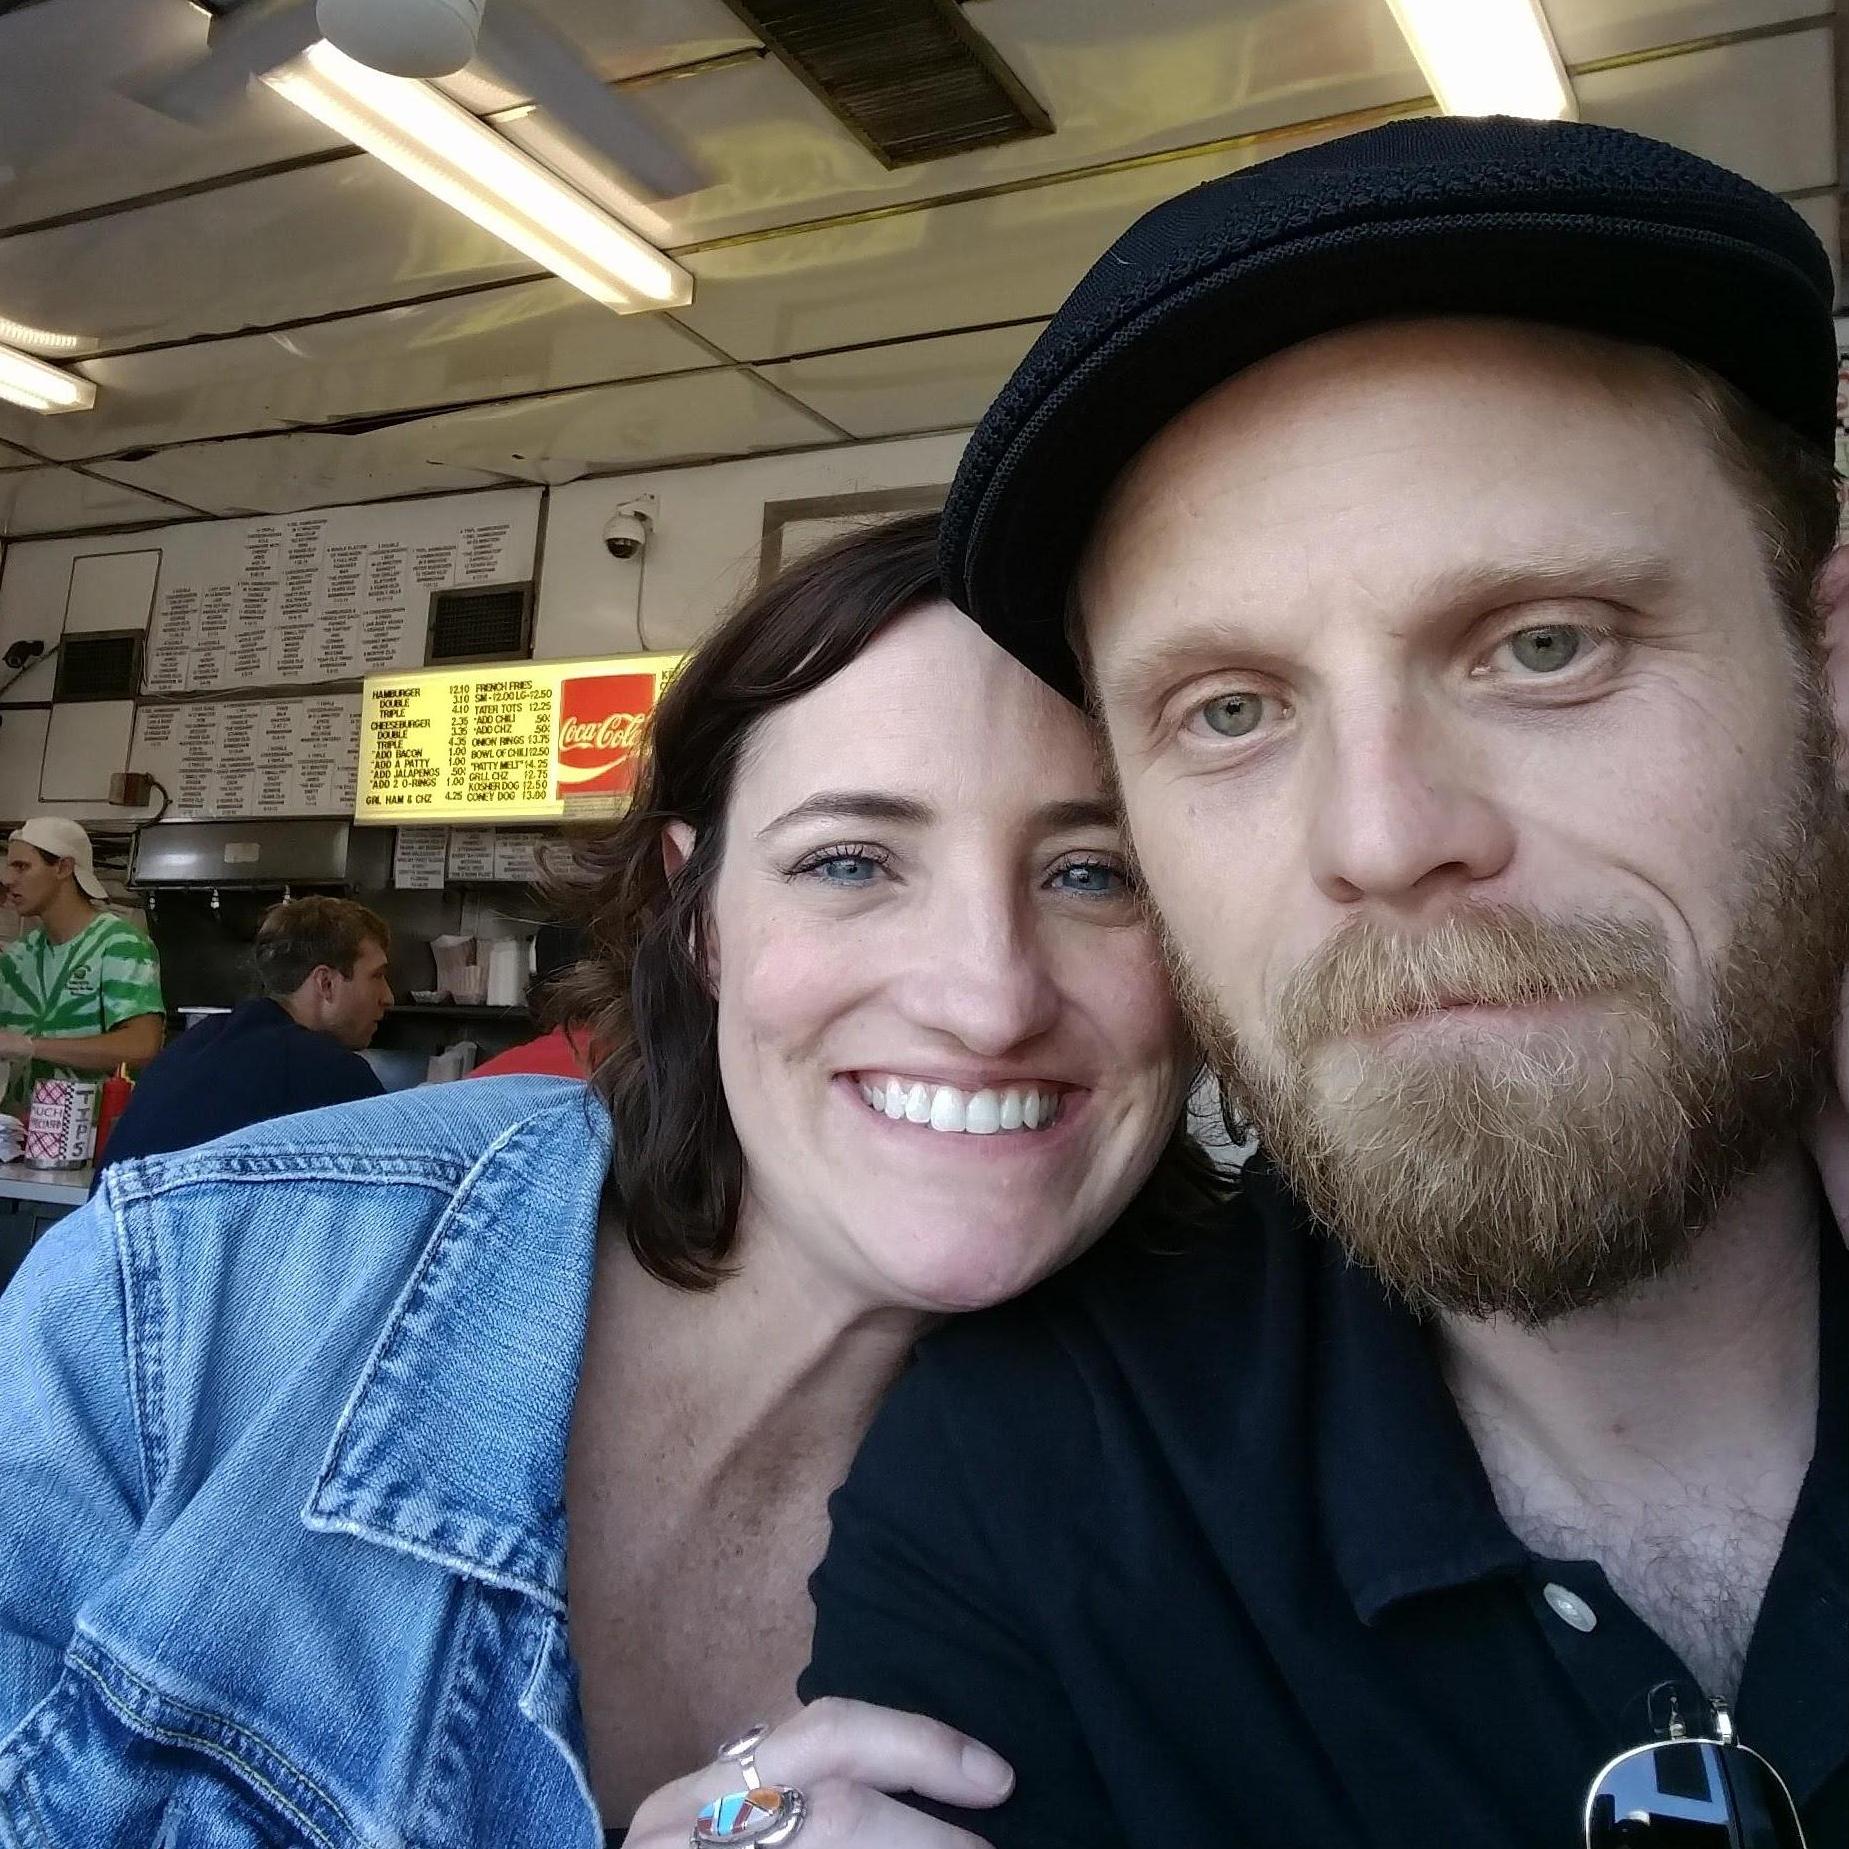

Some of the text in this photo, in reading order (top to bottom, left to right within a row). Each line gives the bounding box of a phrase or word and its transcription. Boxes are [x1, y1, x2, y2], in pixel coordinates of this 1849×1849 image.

[476, 681, 532, 692] FRENCH FRIES
[372, 688, 420, 699] HAMBURGER
[380, 695, 469, 708] DOUBLE 3.10
[380, 705, 469, 718] TRIPLE 4.10
[475, 705, 498, 714] TATER
[502, 703, 522, 713] TOTS
[371, 717, 468, 730] CHEESEBURGER 2.35
[496, 714, 515, 723] CHILI
[378, 730, 408, 739] DOUBLE
[494, 724, 512, 734] CHZ
[377, 740, 403, 749] TRIPLE
[472, 737, 497, 747] ONION
[500, 735, 524, 746] RINGS
[396, 749, 422, 758] BACON
[449, 747, 466, 756] 1.00
[471, 750, 494, 759] BOWL
[496, 749, 507, 758] OF
[508, 748, 528, 757] CHILI
[404, 758, 430, 767] PATTY
[449, 757, 466, 766] 1.00
[492, 772, 508, 780] CHZ
[393, 779, 398, 788] 2
[447, 777, 464, 786] 1.00
[469, 782, 500, 792] KOSHER
[502, 781, 519, 790] DOG
[386, 794, 404, 804] HAM
[416, 794, 432, 803] CHZ
[445, 791, 462, 800] 4.25
[467, 792, 494, 802] CONEY
[498, 792, 515, 801] DOG
[73, 1090, 94, 1156] TIPS
